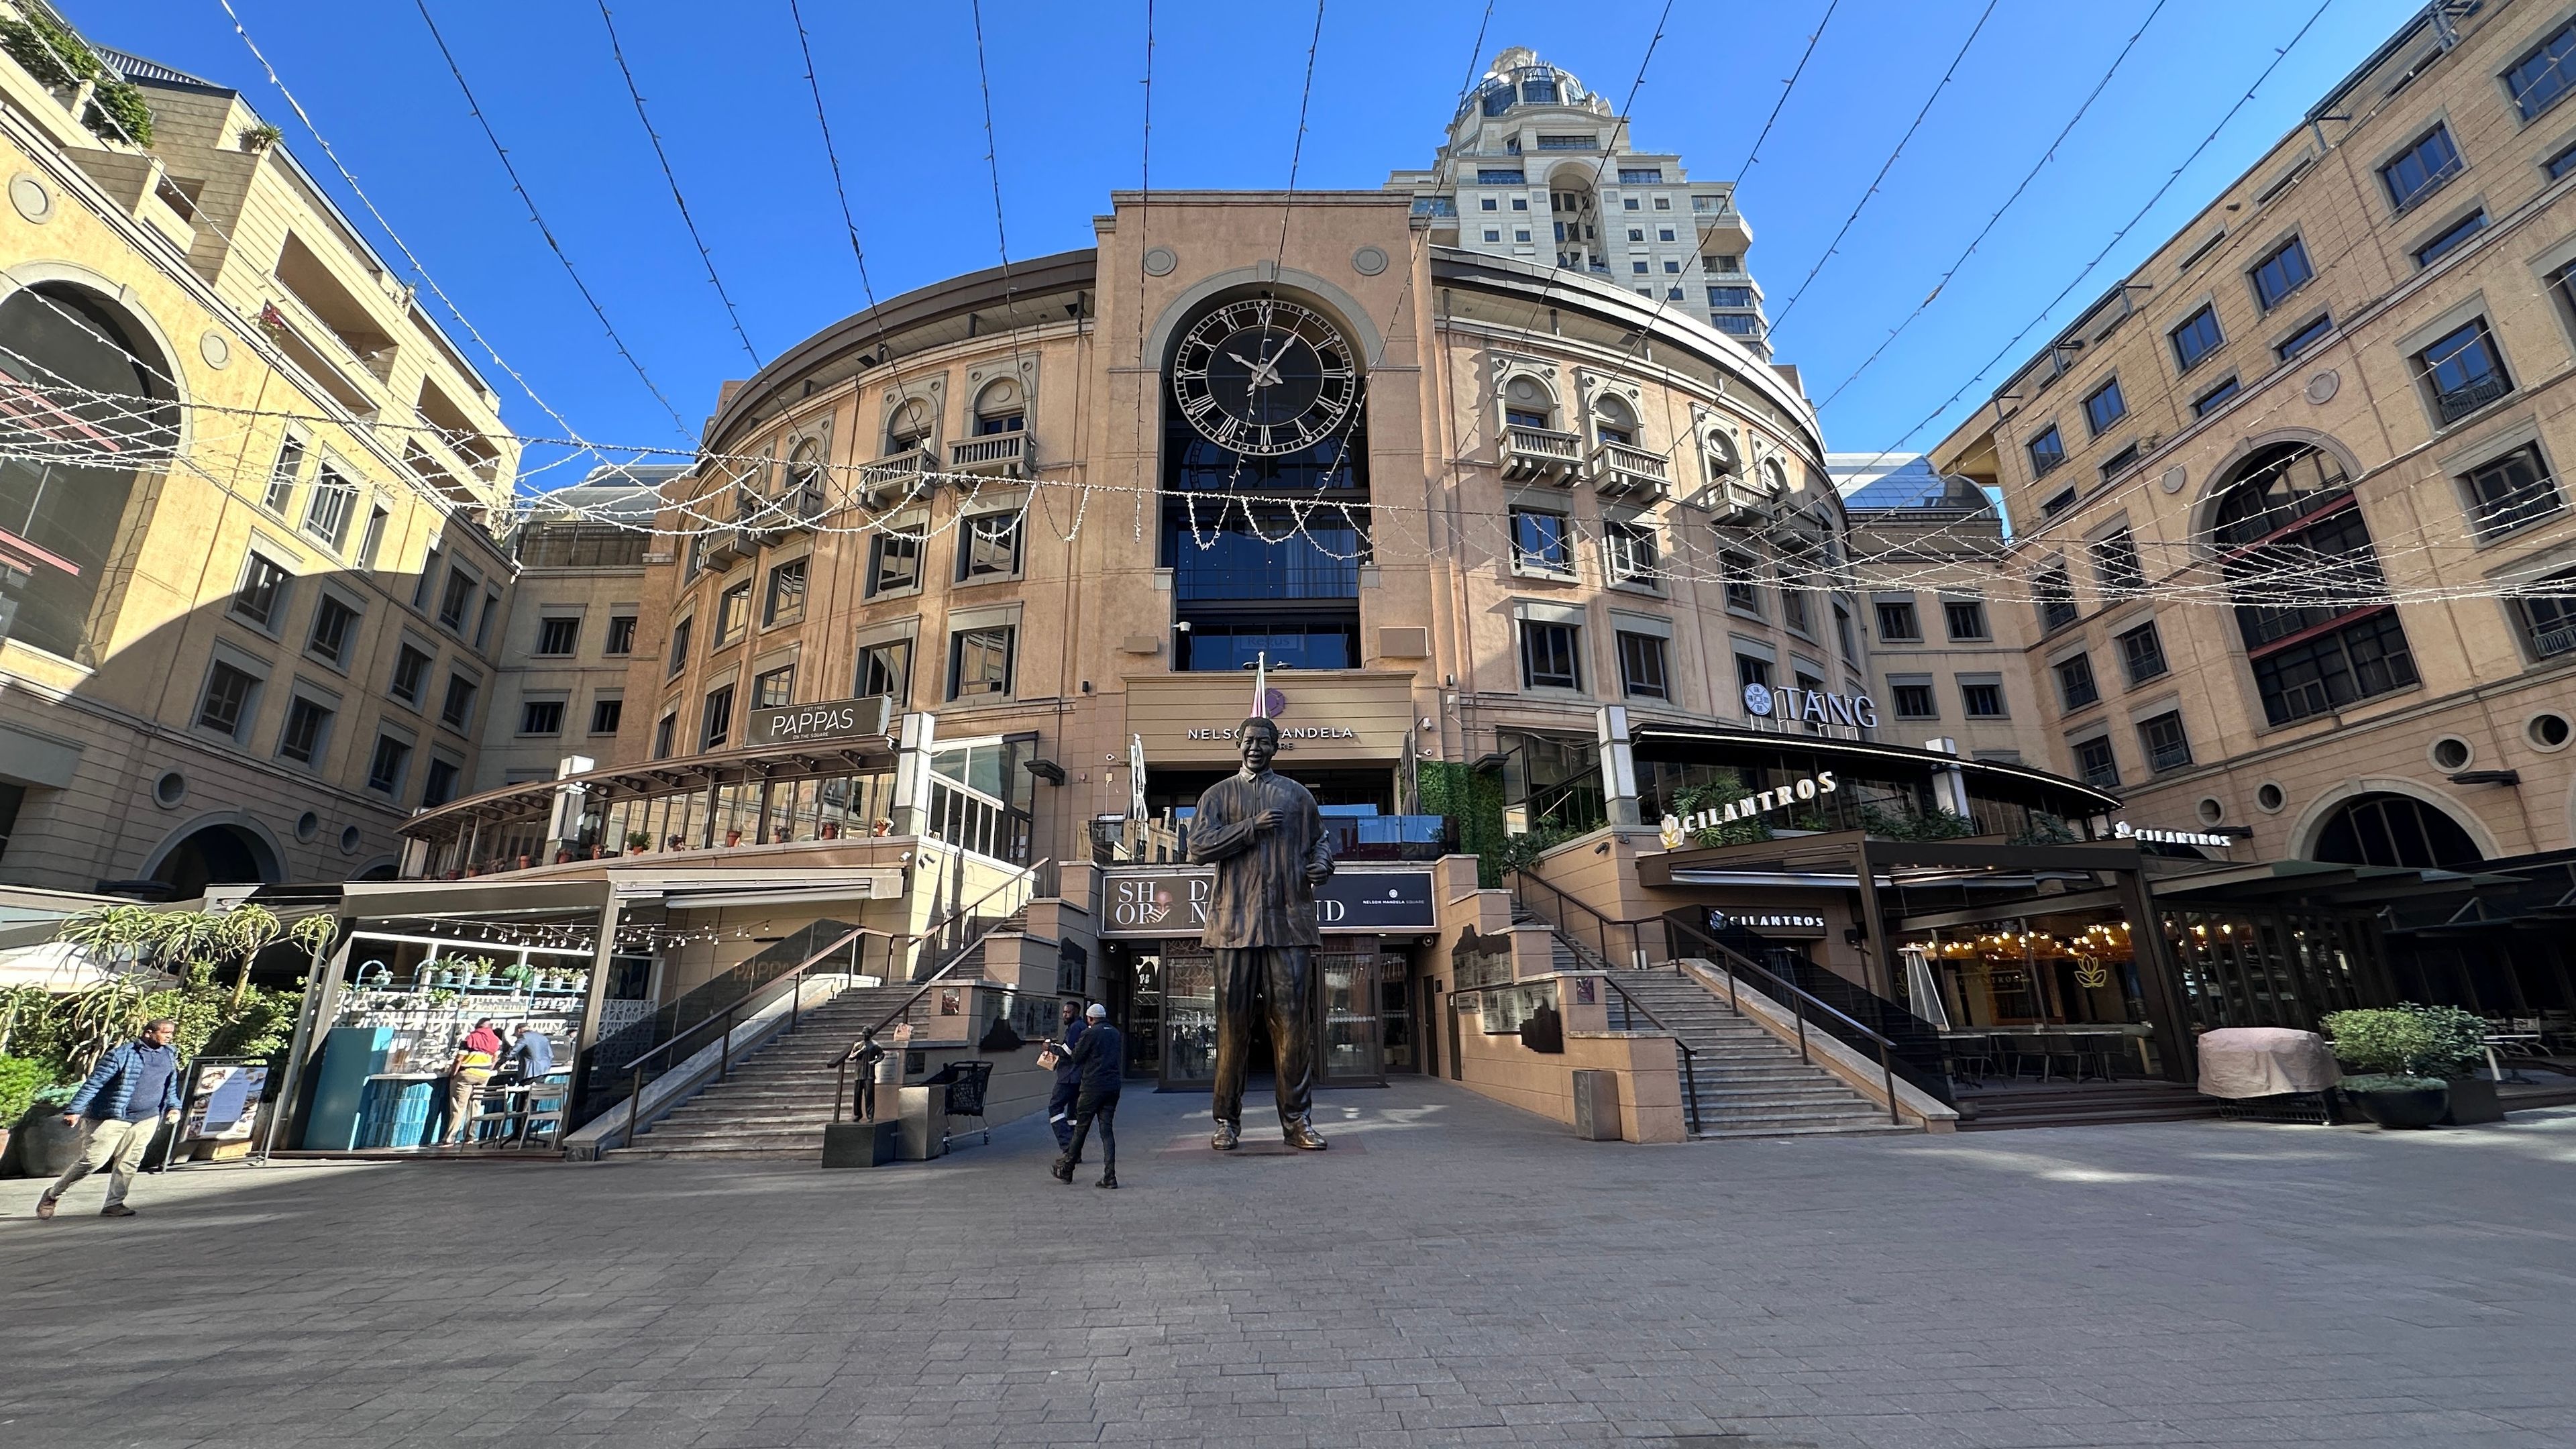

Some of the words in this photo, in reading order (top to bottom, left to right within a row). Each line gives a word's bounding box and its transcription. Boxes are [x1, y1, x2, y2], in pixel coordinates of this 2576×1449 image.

[1248, 637, 1290, 647] Regus
[1778, 686, 1878, 728] TANG
[771, 708, 854, 737] PAPPAS
[1187, 729, 1240, 739] NELSO
[1281, 727, 1353, 739] ANDELA
[1682, 771, 1836, 833] CILANTROS
[2135, 828, 2231, 847] CILANTROS
[1729, 916, 1825, 927] CILANTROS
[734, 961, 790, 981] PAPPA
